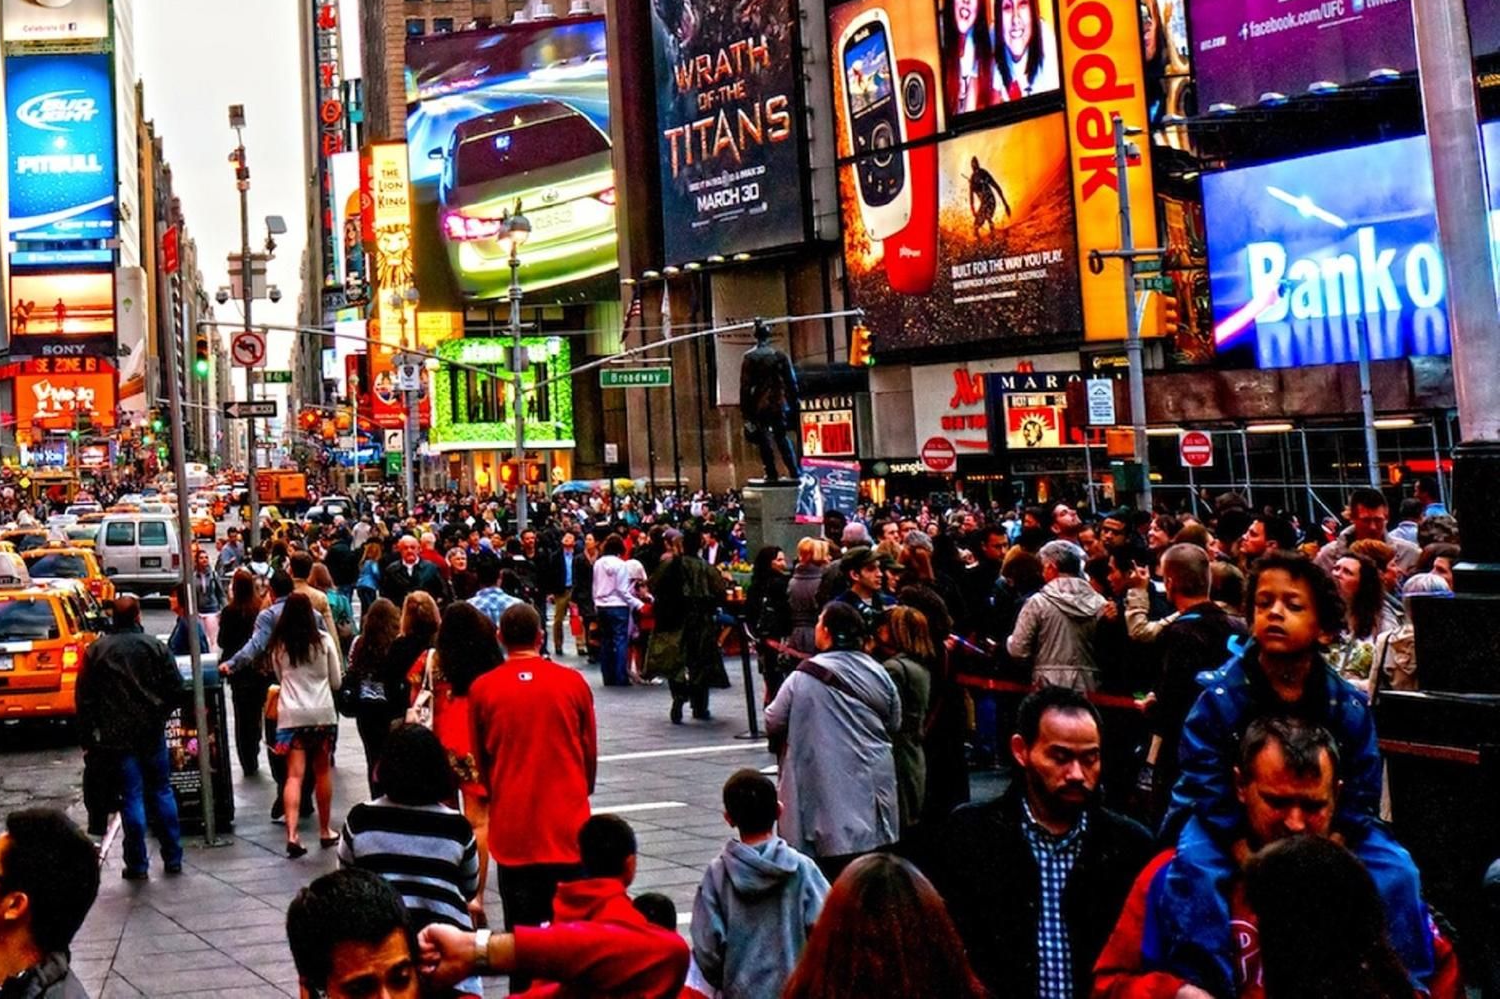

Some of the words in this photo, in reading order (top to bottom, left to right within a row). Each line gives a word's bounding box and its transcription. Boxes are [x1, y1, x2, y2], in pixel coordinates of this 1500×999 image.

[1250, 0, 1345, 37] facebook.com/UFC
[674, 35, 772, 93] WRATH
[664, 95, 790, 179] TITANS
[16, 154, 103, 174] PITBULL
[382, 168, 398, 177] THE
[379, 180, 403, 192] LION
[378, 195, 406, 208] KING
[697, 187, 740, 211] MARCH
[742, 183, 759, 203] 30
[952, 263, 971, 279] BUILT
[973, 261, 988, 275] FOR
[988, 258, 1004, 272] THE
[1005, 255, 1024, 269] WAY
[1024, 252, 1041, 267] YOU
[1042, 249, 1064, 264] PLAY.
[1248, 226, 1402, 324] Bank
[42, 344, 86, 355] SONY
[55, 357, 82, 372] ZONE
[611, 372, 661, 384] Broadway
[800, 397, 853, 410] MARQUIS
